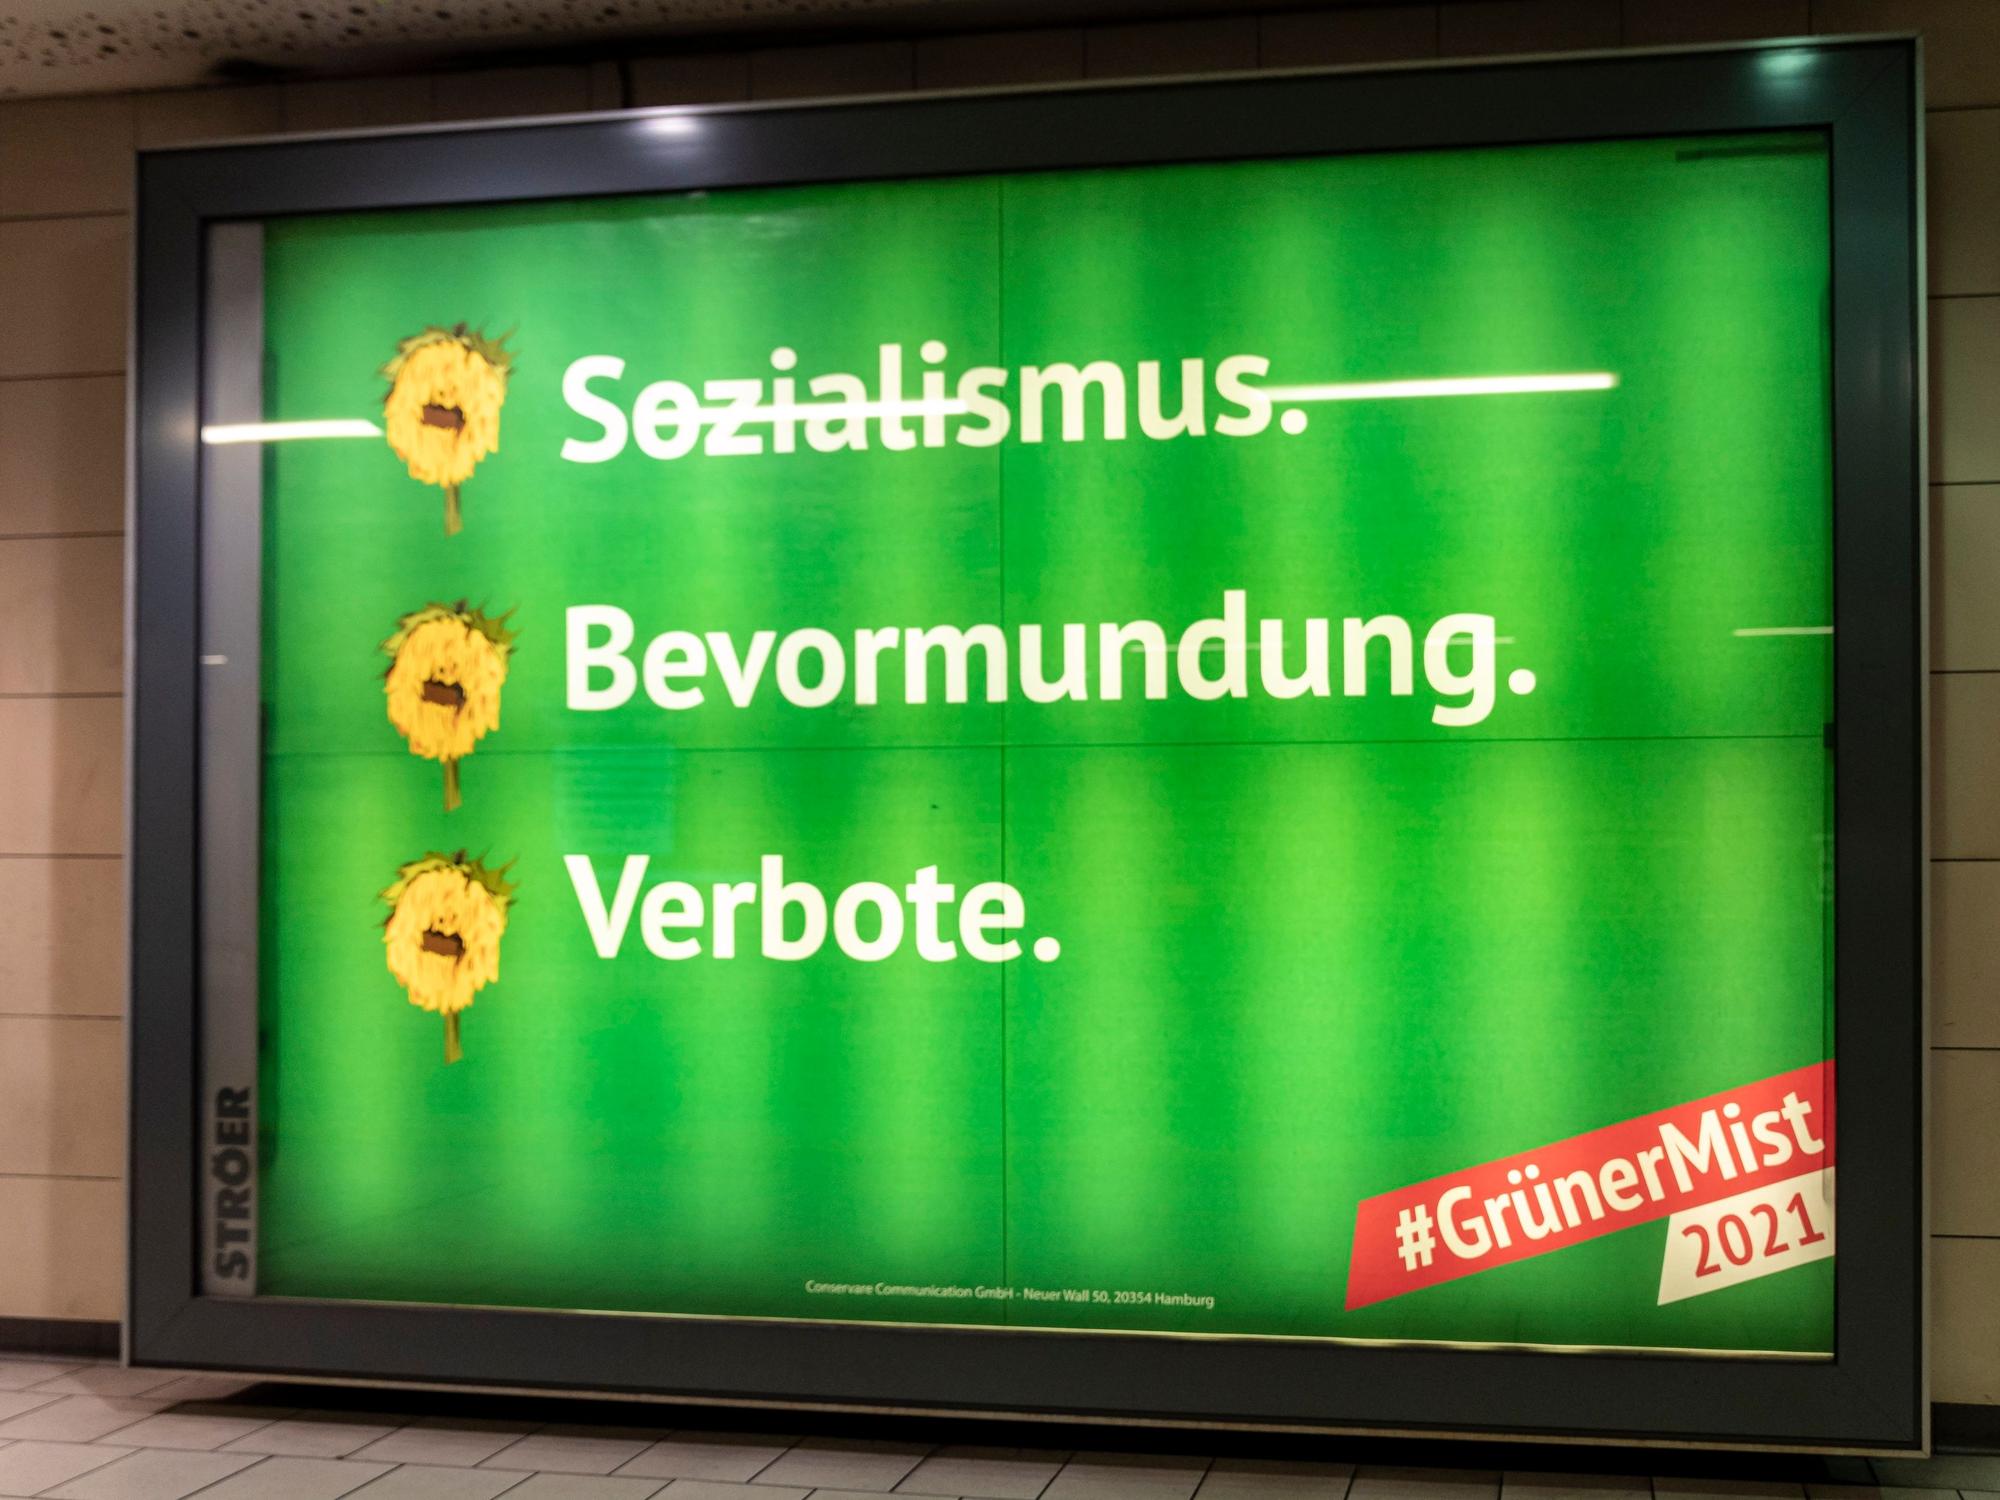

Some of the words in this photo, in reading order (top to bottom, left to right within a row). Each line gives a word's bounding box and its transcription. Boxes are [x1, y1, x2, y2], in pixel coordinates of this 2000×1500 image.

[560, 340, 1309, 464] Sozialismus.
[564, 589, 1538, 728] Bevormundung.
[563, 853, 1062, 962] Verbote.
[213, 1086, 251, 1280] STRÖER
[1395, 1091, 1826, 1272] #GrünerMist
[1681, 1191, 1826, 1278] 2021
[805, 1279, 873, 1295] Conservare
[875, 1282, 973, 1298] Communication
[974, 1285, 1014, 1300] GmbH
[1023, 1288, 1062, 1301] Neuer
[1062, 1289, 1090, 1303] Wall
[1092, 1290, 1111, 1304] 50,
[1113, 1291, 1152, 1305] 20354
[1154, 1292, 1215, 1309] Hamburg
